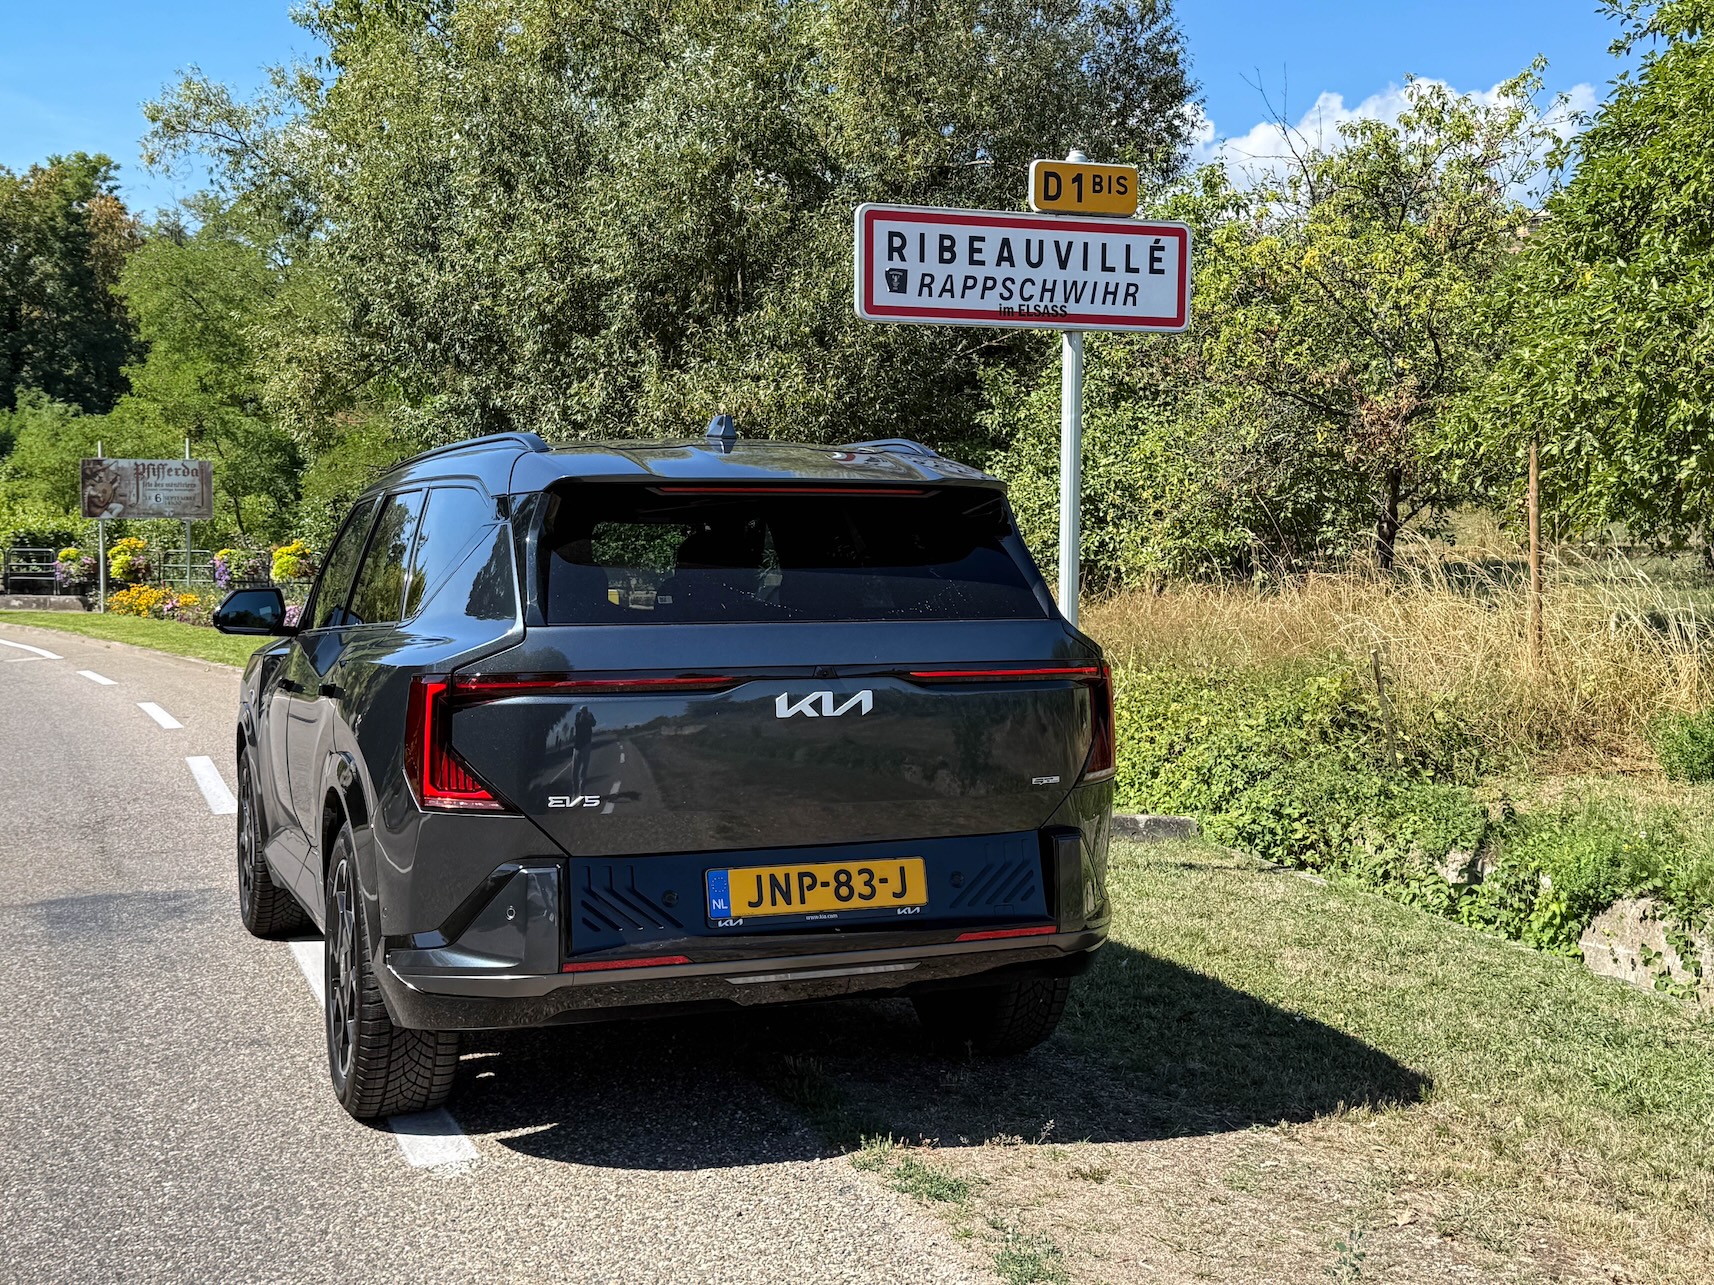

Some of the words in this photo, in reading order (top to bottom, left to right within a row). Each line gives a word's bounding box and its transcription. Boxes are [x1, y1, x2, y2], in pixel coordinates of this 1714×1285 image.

[1043, 171, 1063, 201] D
[1072, 173, 1083, 203] 1
[1091, 174, 1129, 195] BIS
[887, 230, 1166, 275] RIBEAUVILLÉ
[917, 273, 1139, 306] RAPPSCHWIHR
[999, 303, 1014, 317] im
[1017, 304, 1068, 318] ELSASS
[155, 493, 162, 503] 6
[775, 690, 873, 718] KIA
[548, 795, 600, 808] EV5
[748, 866, 908, 908] JNP-83-J
[712, 898, 728, 910] NL
[897, 907, 921, 915] KIA
[718, 919, 743, 927] KIA
